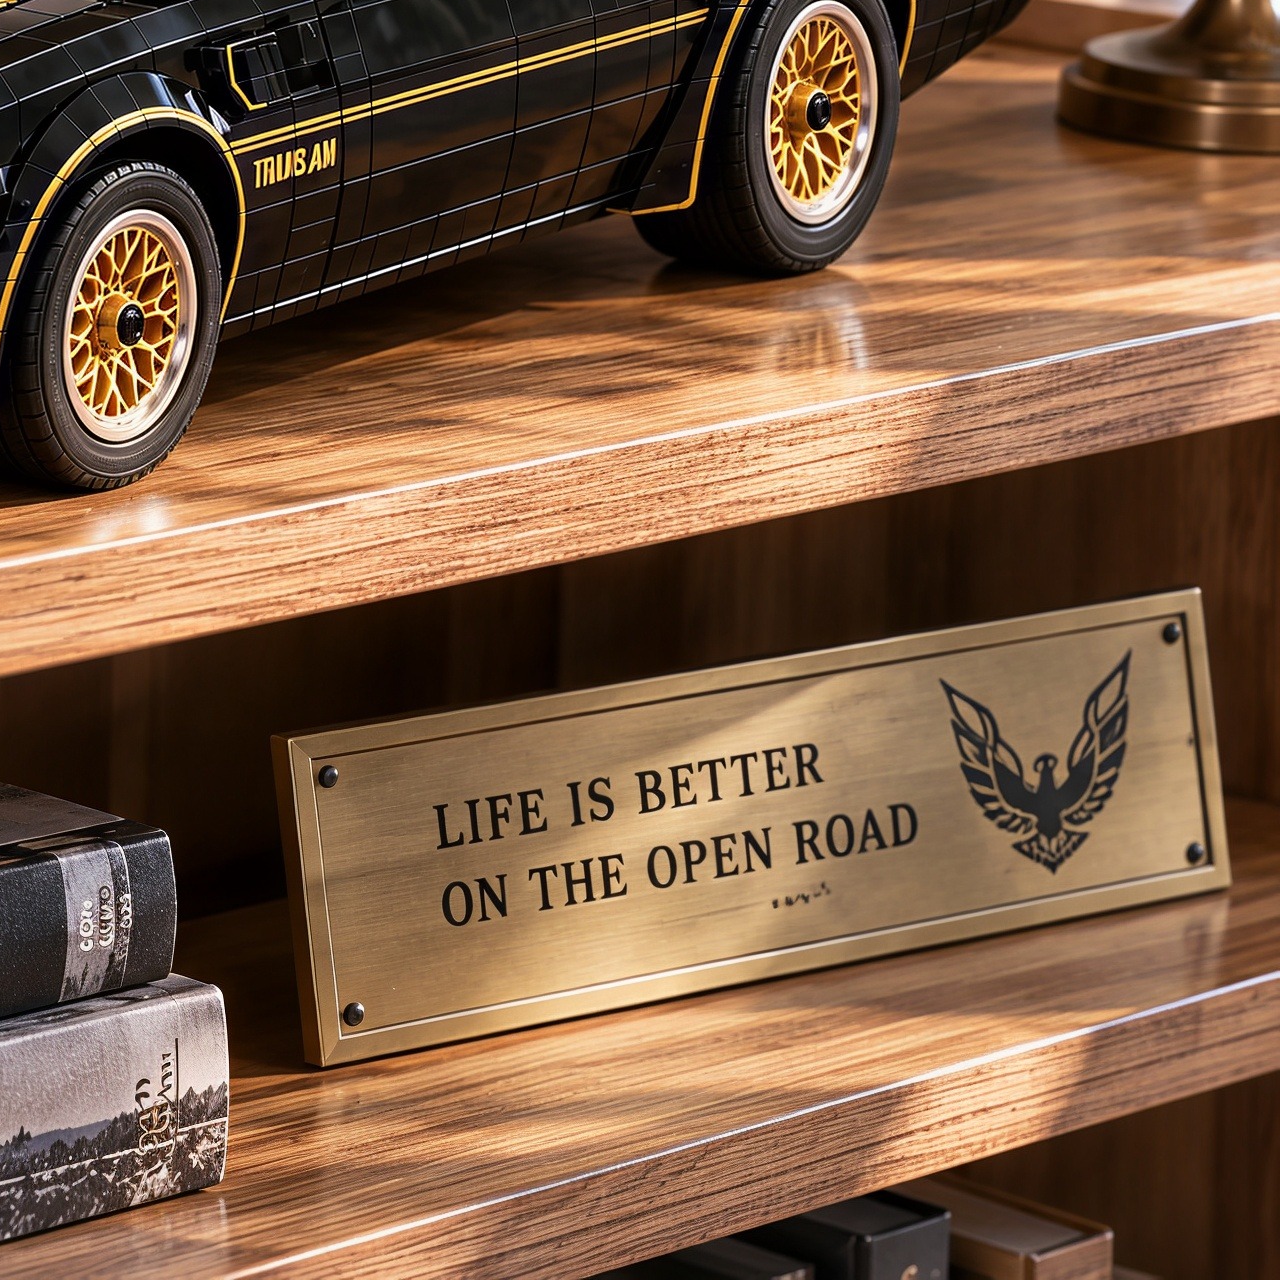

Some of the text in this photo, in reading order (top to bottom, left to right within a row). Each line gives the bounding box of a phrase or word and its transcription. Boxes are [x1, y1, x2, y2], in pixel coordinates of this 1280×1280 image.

[432, 743, 825, 851] LIFE IS BETTER
[441, 802, 920, 927] ON THE OPEN ROAD
